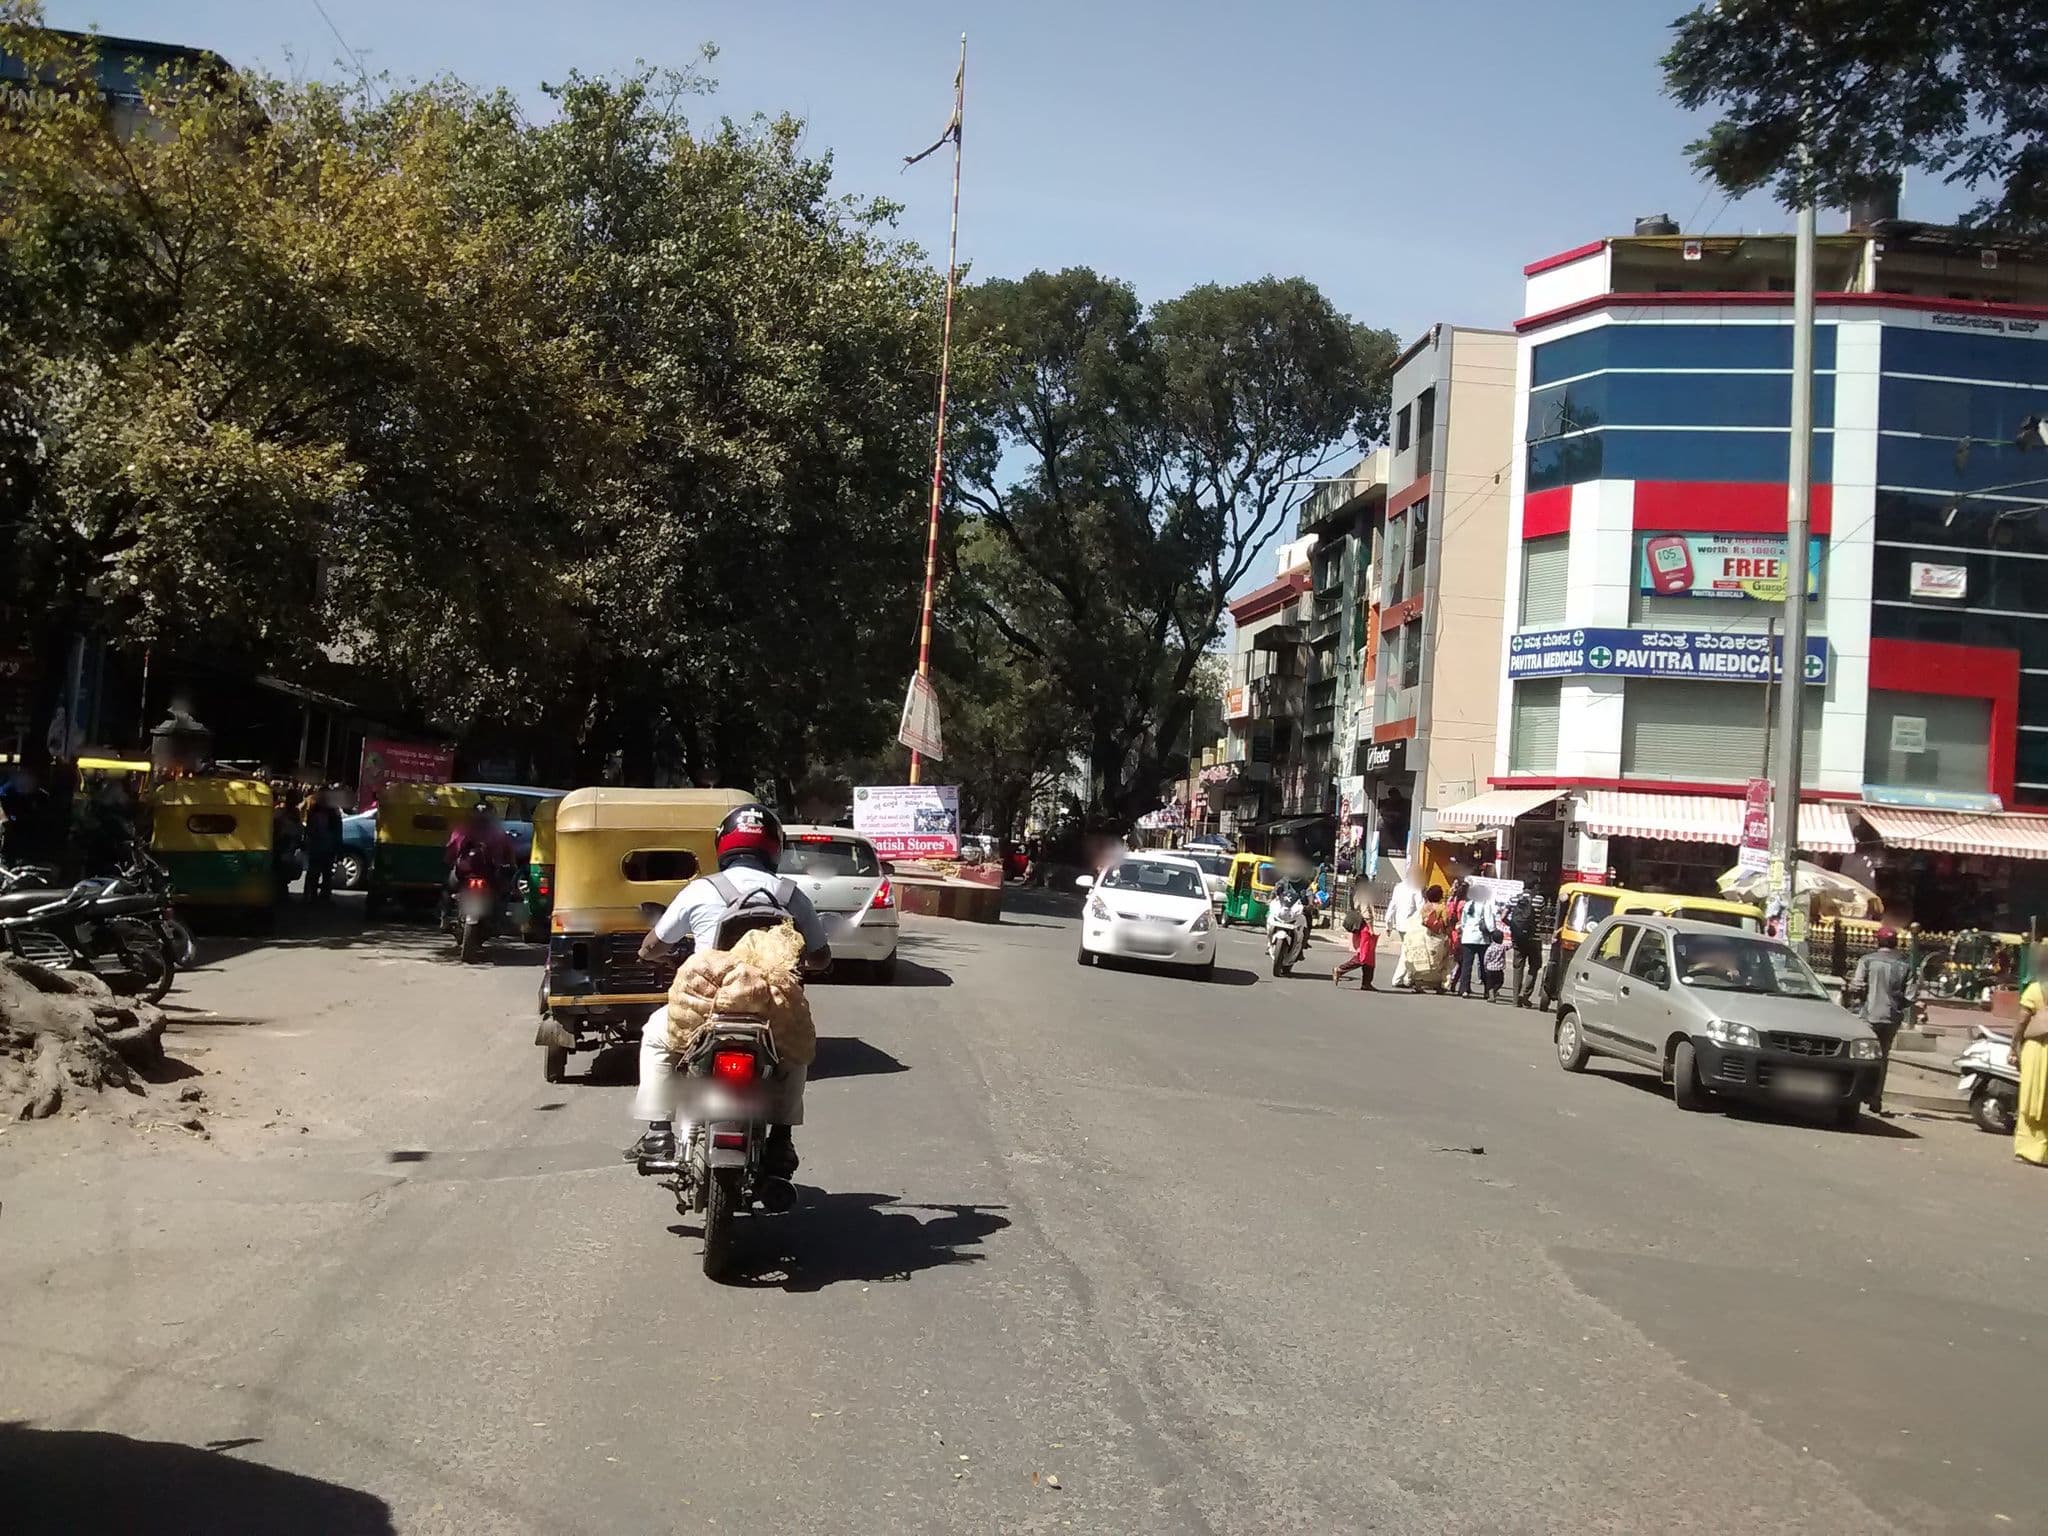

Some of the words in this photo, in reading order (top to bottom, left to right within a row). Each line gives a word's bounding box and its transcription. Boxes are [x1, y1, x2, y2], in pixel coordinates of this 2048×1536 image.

[1697, 545, 1728, 554] worth
[1736, 537, 1788, 545] medicine
[1723, 558, 1779, 578] FREE
[1642, 632, 1689, 650] ಪವಿತ್ರ
[1510, 653, 1542, 671] PAVITRA
[1543, 649, 1584, 668] MEDICALS
[1615, 649, 1694, 670] PAVITRA
[1699, 653, 1783, 674] MEDICAL
[907, 838, 944, 850] Stores
